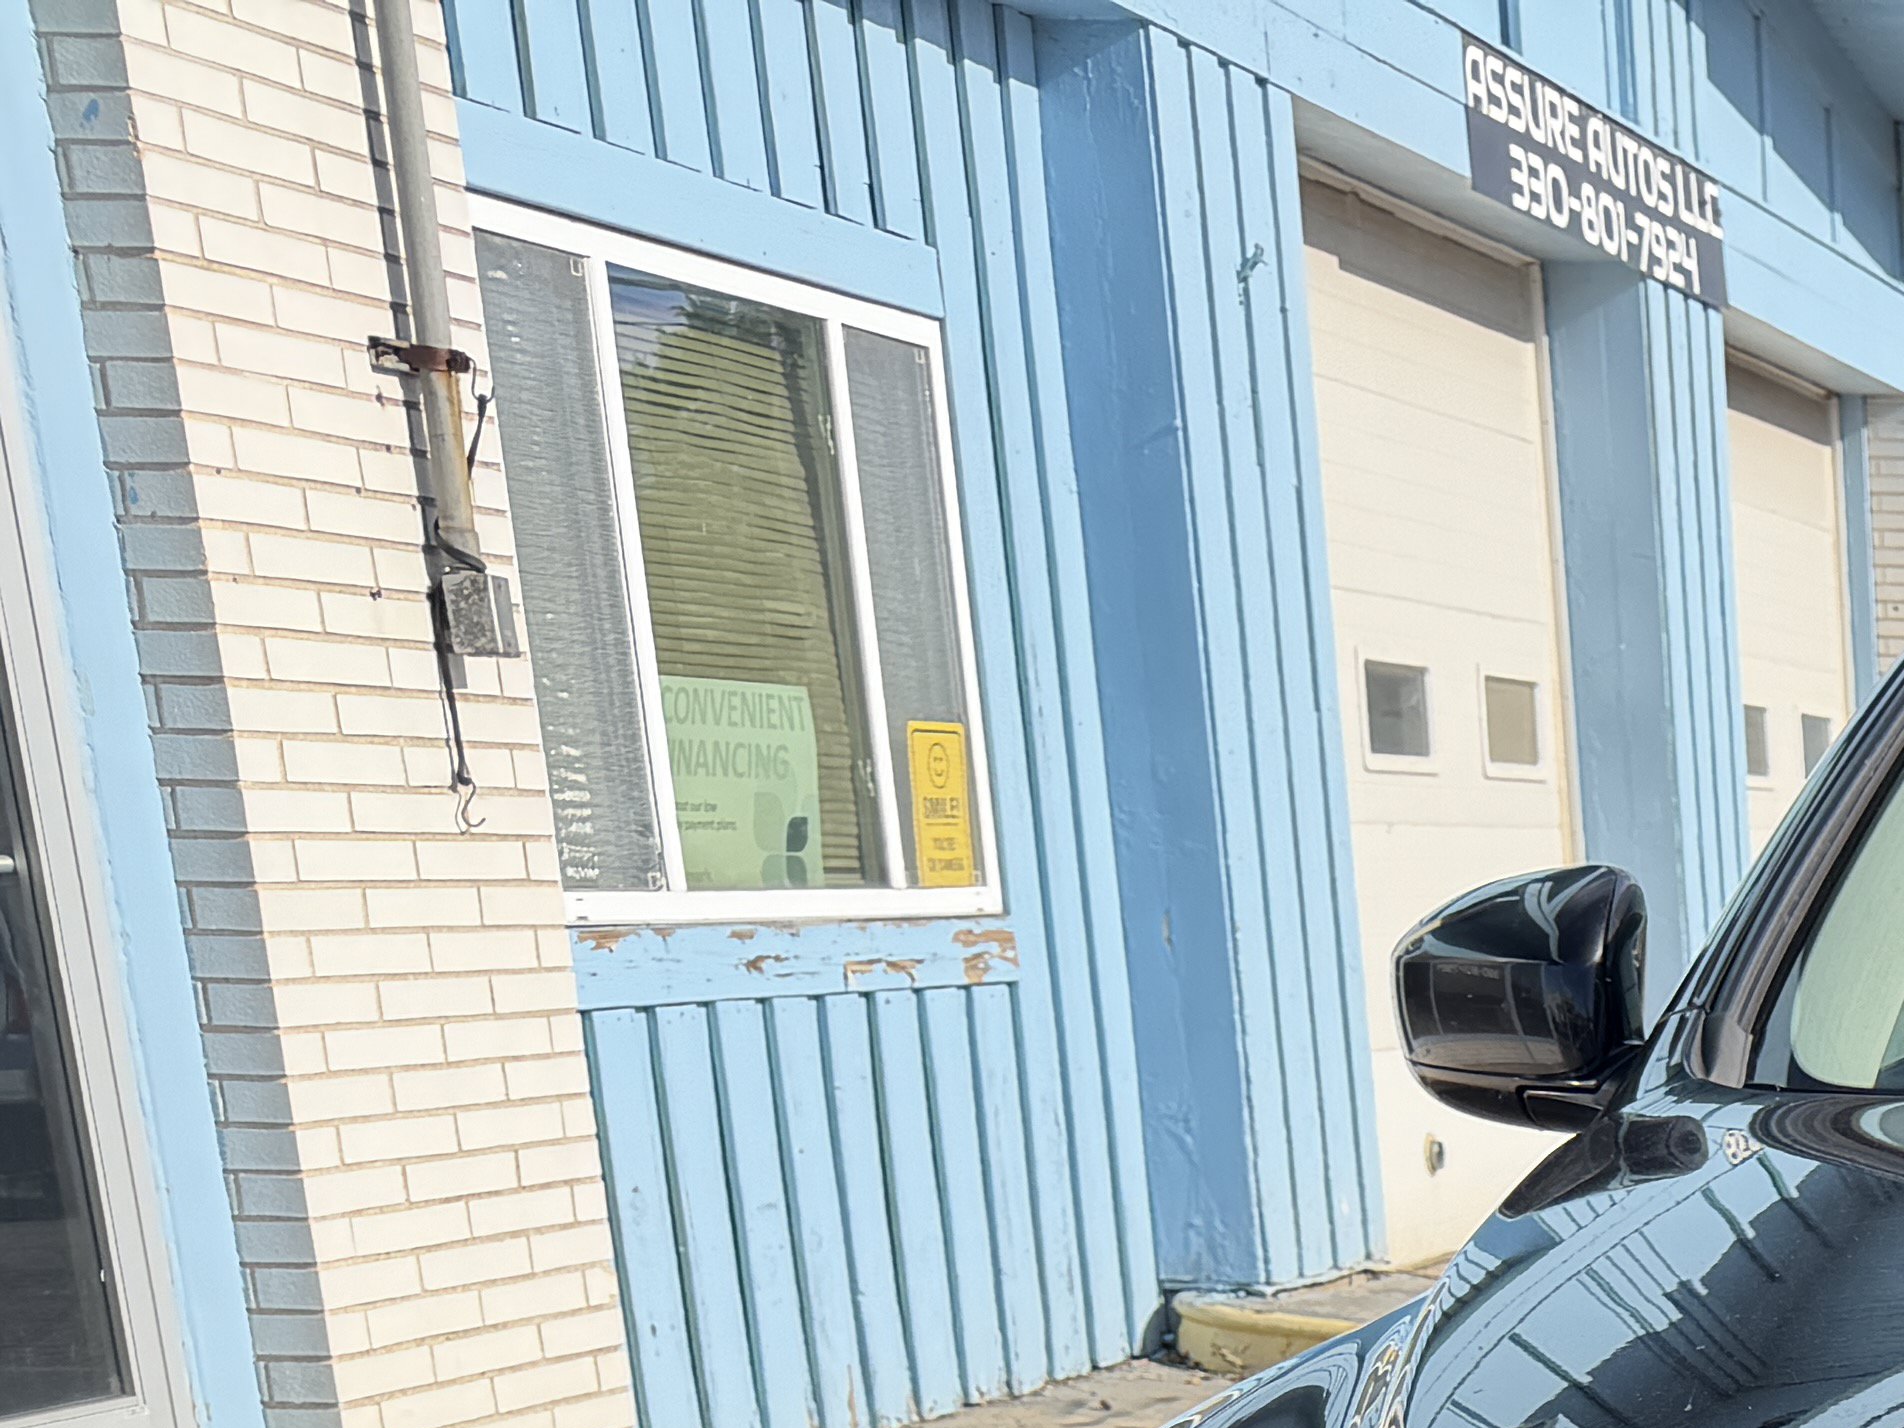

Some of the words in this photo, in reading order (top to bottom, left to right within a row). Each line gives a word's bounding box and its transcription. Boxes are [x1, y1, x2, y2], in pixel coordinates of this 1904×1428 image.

[1465, 45, 1583, 163] ASSURE
[1587, 115, 1674, 217] AUTOS
[1675, 164, 1724, 239] LLC
[1509, 144, 1700, 294] 330-801-7924
[662, 685, 805, 731] CONVENIENT
[669, 739, 790, 780] INANCING
